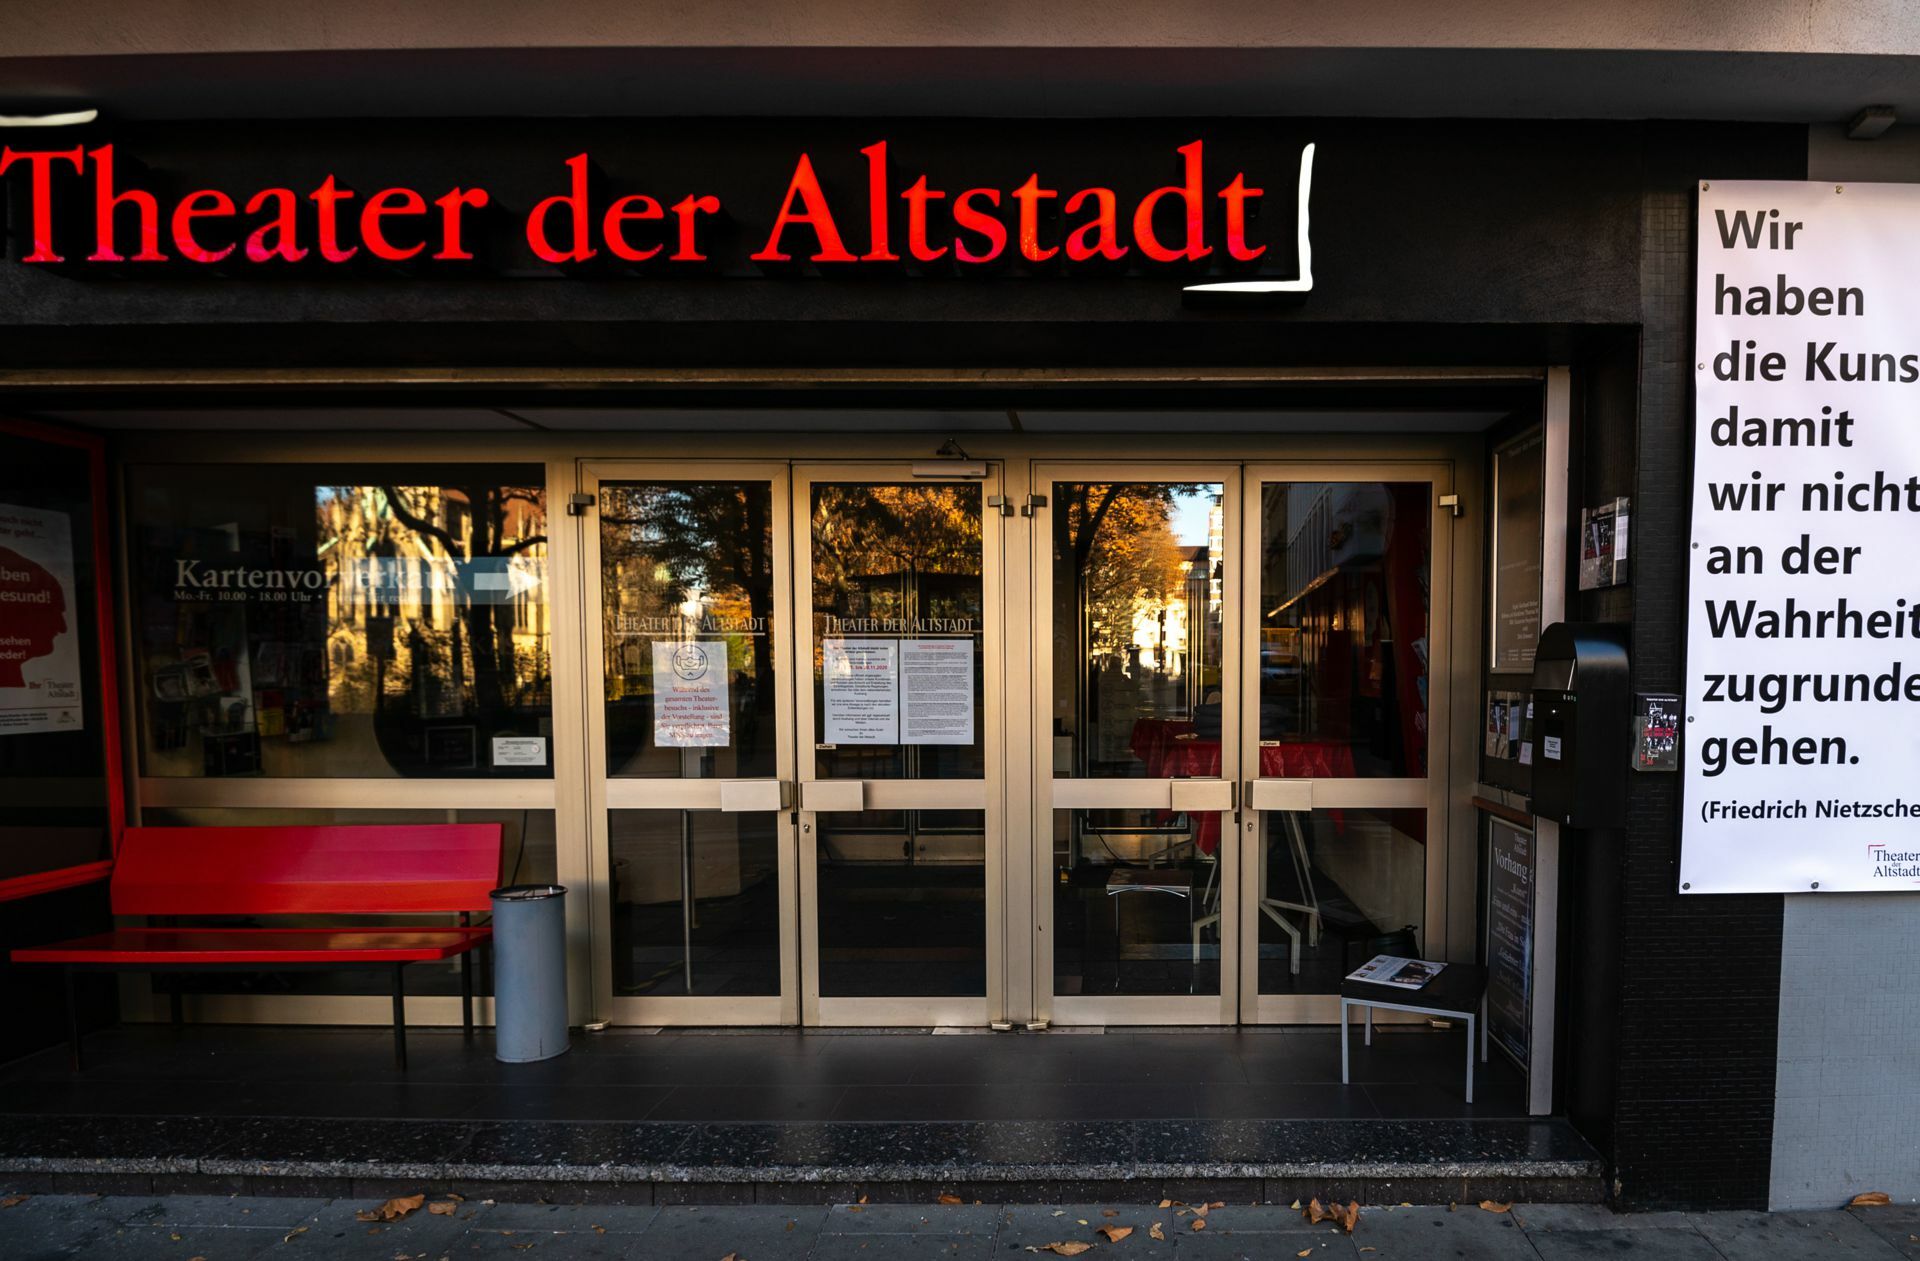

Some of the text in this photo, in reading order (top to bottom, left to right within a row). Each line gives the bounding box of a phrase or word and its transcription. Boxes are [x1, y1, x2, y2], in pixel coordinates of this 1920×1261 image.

[0, 139, 1267, 263] Theater der Altstadt
[1714, 208, 1804, 250] Wir
[1714, 273, 1865, 317] haben
[1712, 339, 1920, 384] die Kuns
[1710, 405, 1854, 448] damit
[1708, 470, 1920, 513] wir nicht
[1706, 533, 1863, 576] an der
[0, 588, 52, 605] esund!
[217, 591, 248, 602] 10.00
[259, 591, 288, 602] 18.00
[290, 590, 313, 602] Uhr
[824, 614, 974, 632] THEATER DER ALTSTADT
[1703, 597, 1920, 640] Wahrheit
[1702, 661, 1920, 714] zugrunde
[1701, 725, 1861, 778] gehen.
[1701, 798, 1920, 824] (Friedrich Nietzsche
[1494, 846, 1529, 885] Vorhang
[1873, 849, 1920, 862] Theater
